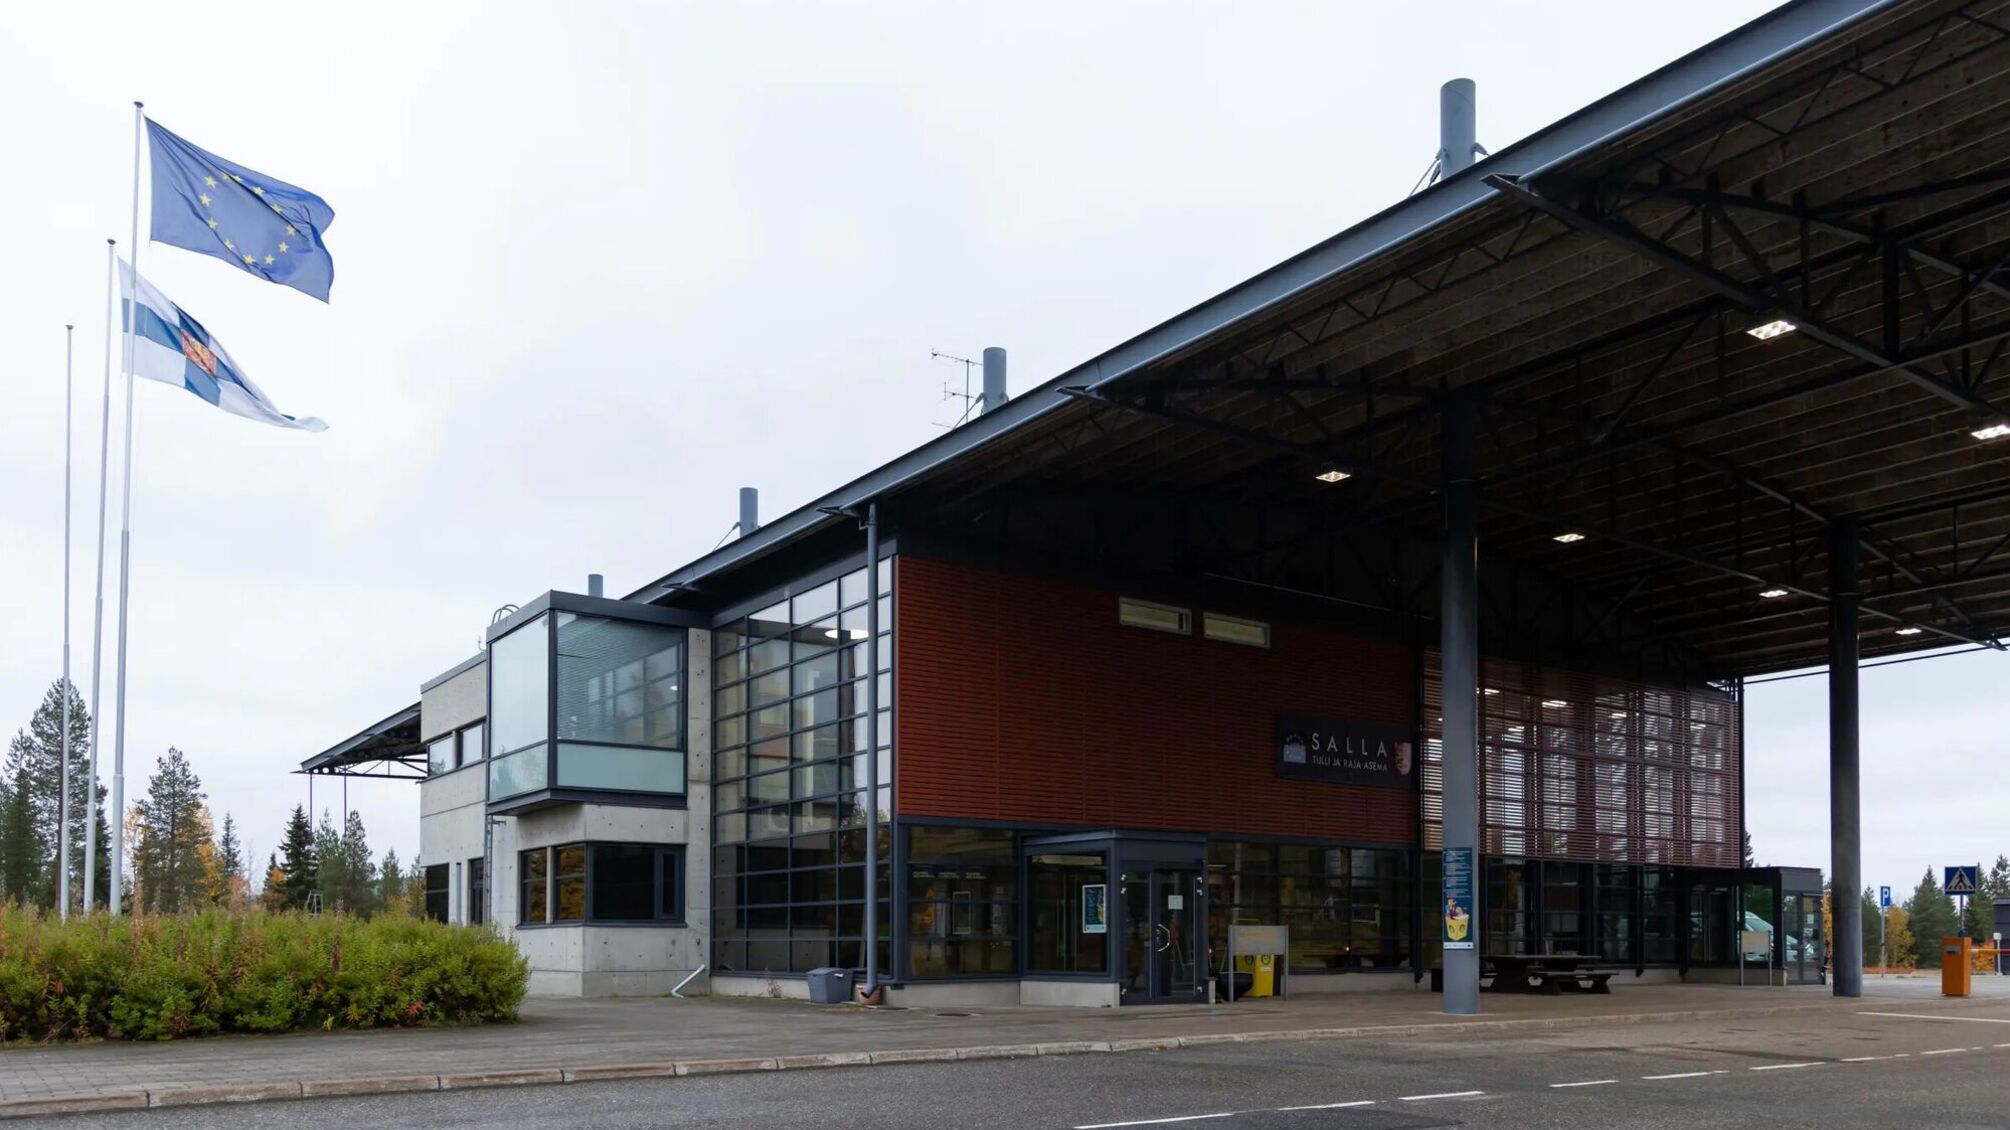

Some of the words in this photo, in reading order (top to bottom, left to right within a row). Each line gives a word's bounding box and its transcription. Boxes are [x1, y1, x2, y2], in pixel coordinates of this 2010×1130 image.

[1312, 732, 1388, 757] SALLA
[1312, 755, 1331, 766] TULLI
[1332, 757, 1341, 767] JA
[1882, 888, 1890, 905] P
